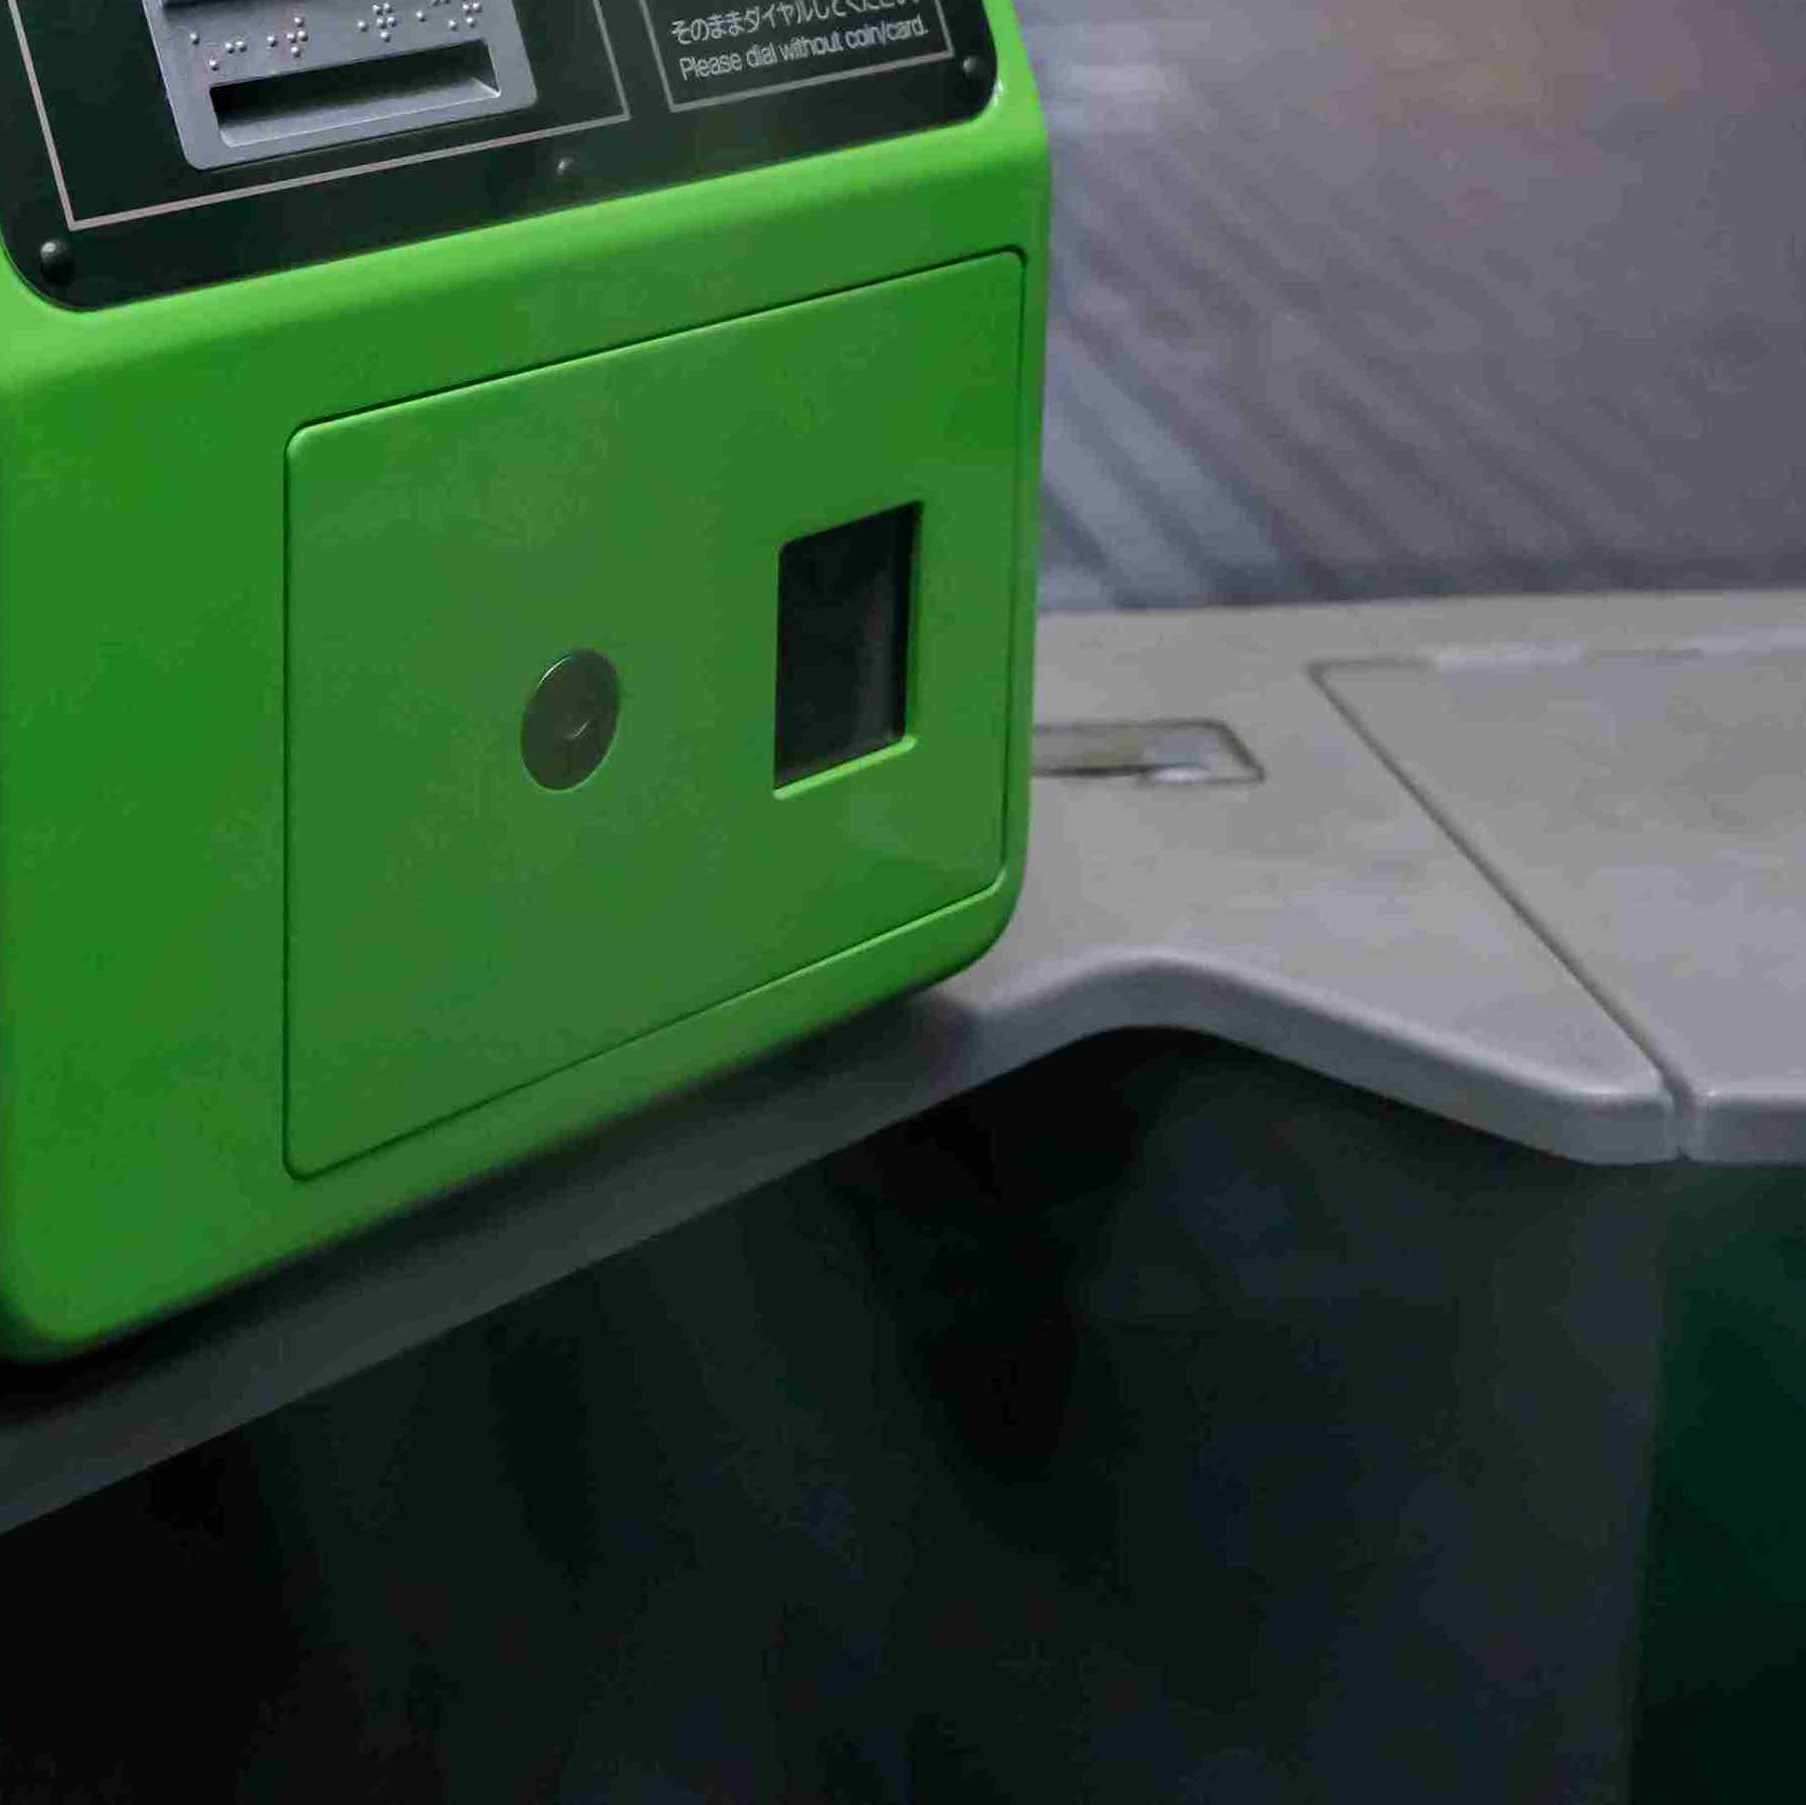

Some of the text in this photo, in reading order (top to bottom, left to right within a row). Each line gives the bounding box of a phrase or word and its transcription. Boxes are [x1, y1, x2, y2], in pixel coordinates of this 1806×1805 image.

[678, 52, 743, 82] Please
[746, 42, 779, 69] dial
[780, 30, 844, 63] without
